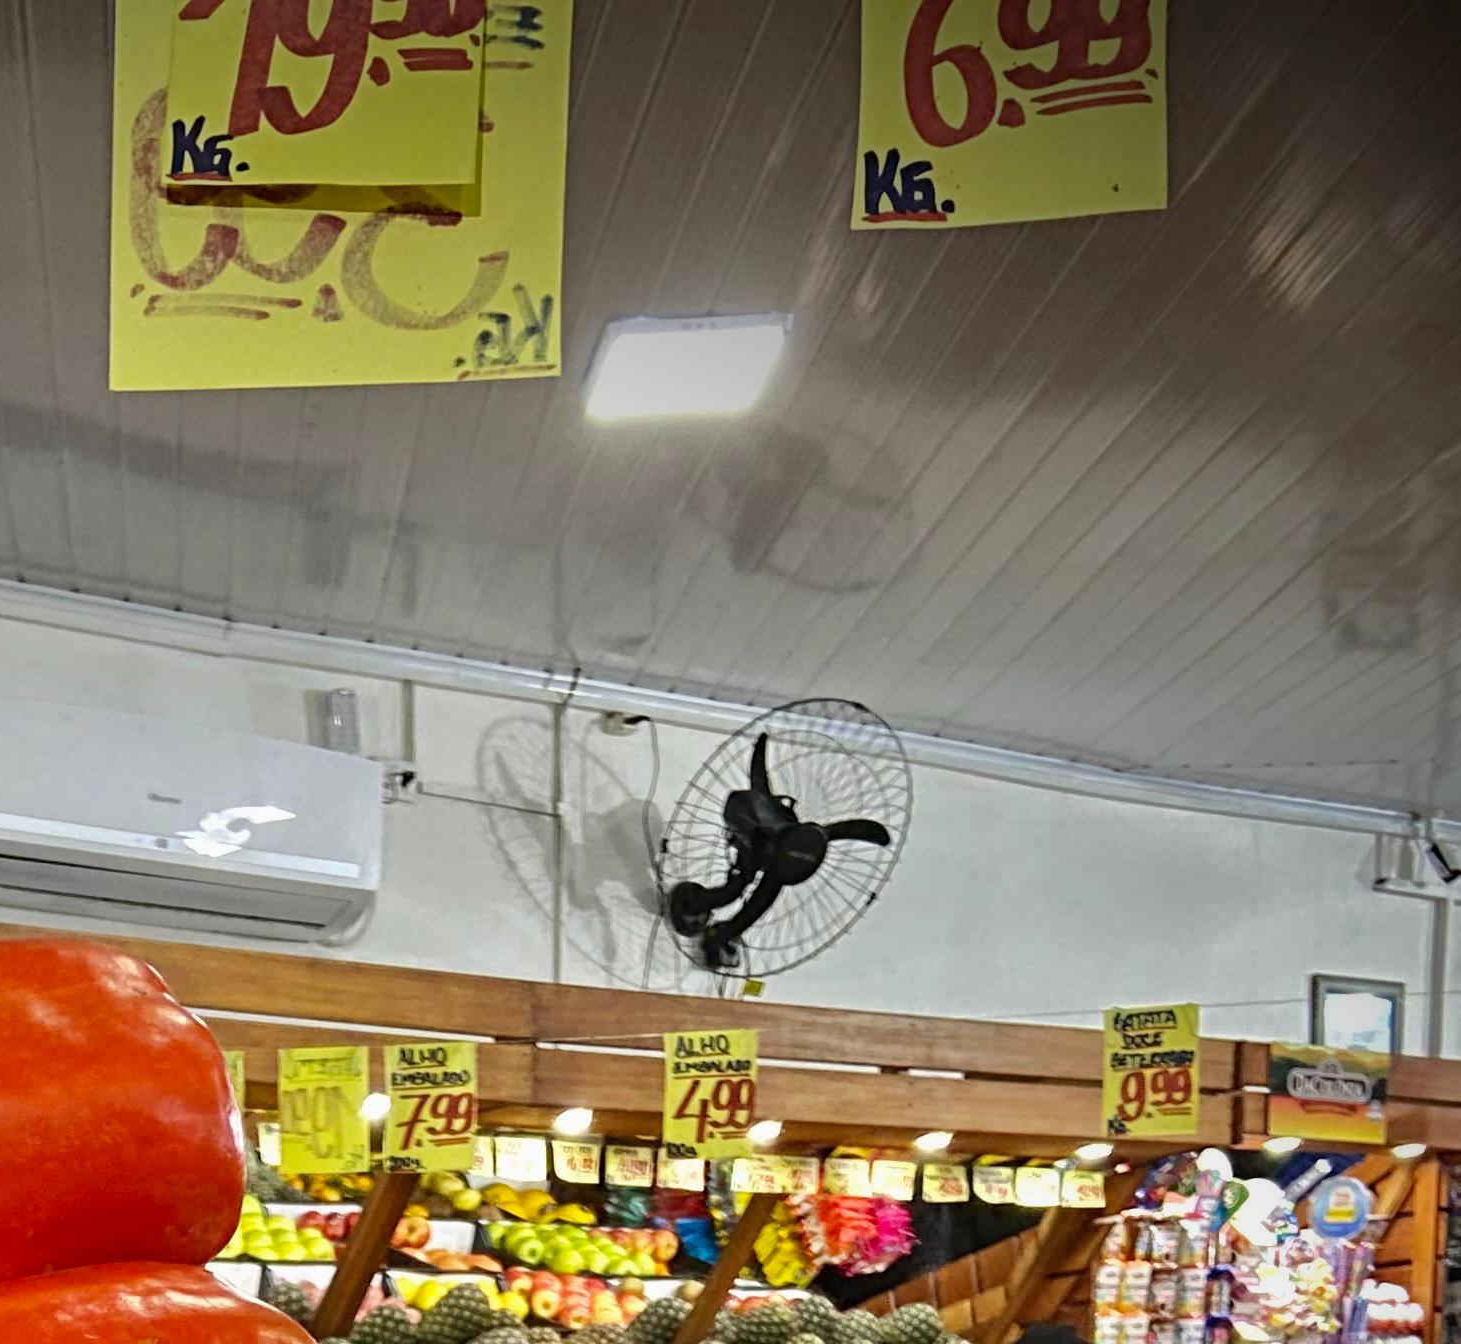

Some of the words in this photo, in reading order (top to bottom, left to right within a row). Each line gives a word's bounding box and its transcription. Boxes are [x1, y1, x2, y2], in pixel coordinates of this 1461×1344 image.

[396, 1093, 474, 1150] 7.99
[672, 1079, 756, 1143] 4.99
[1117, 1068, 1192, 1121] 9.99
